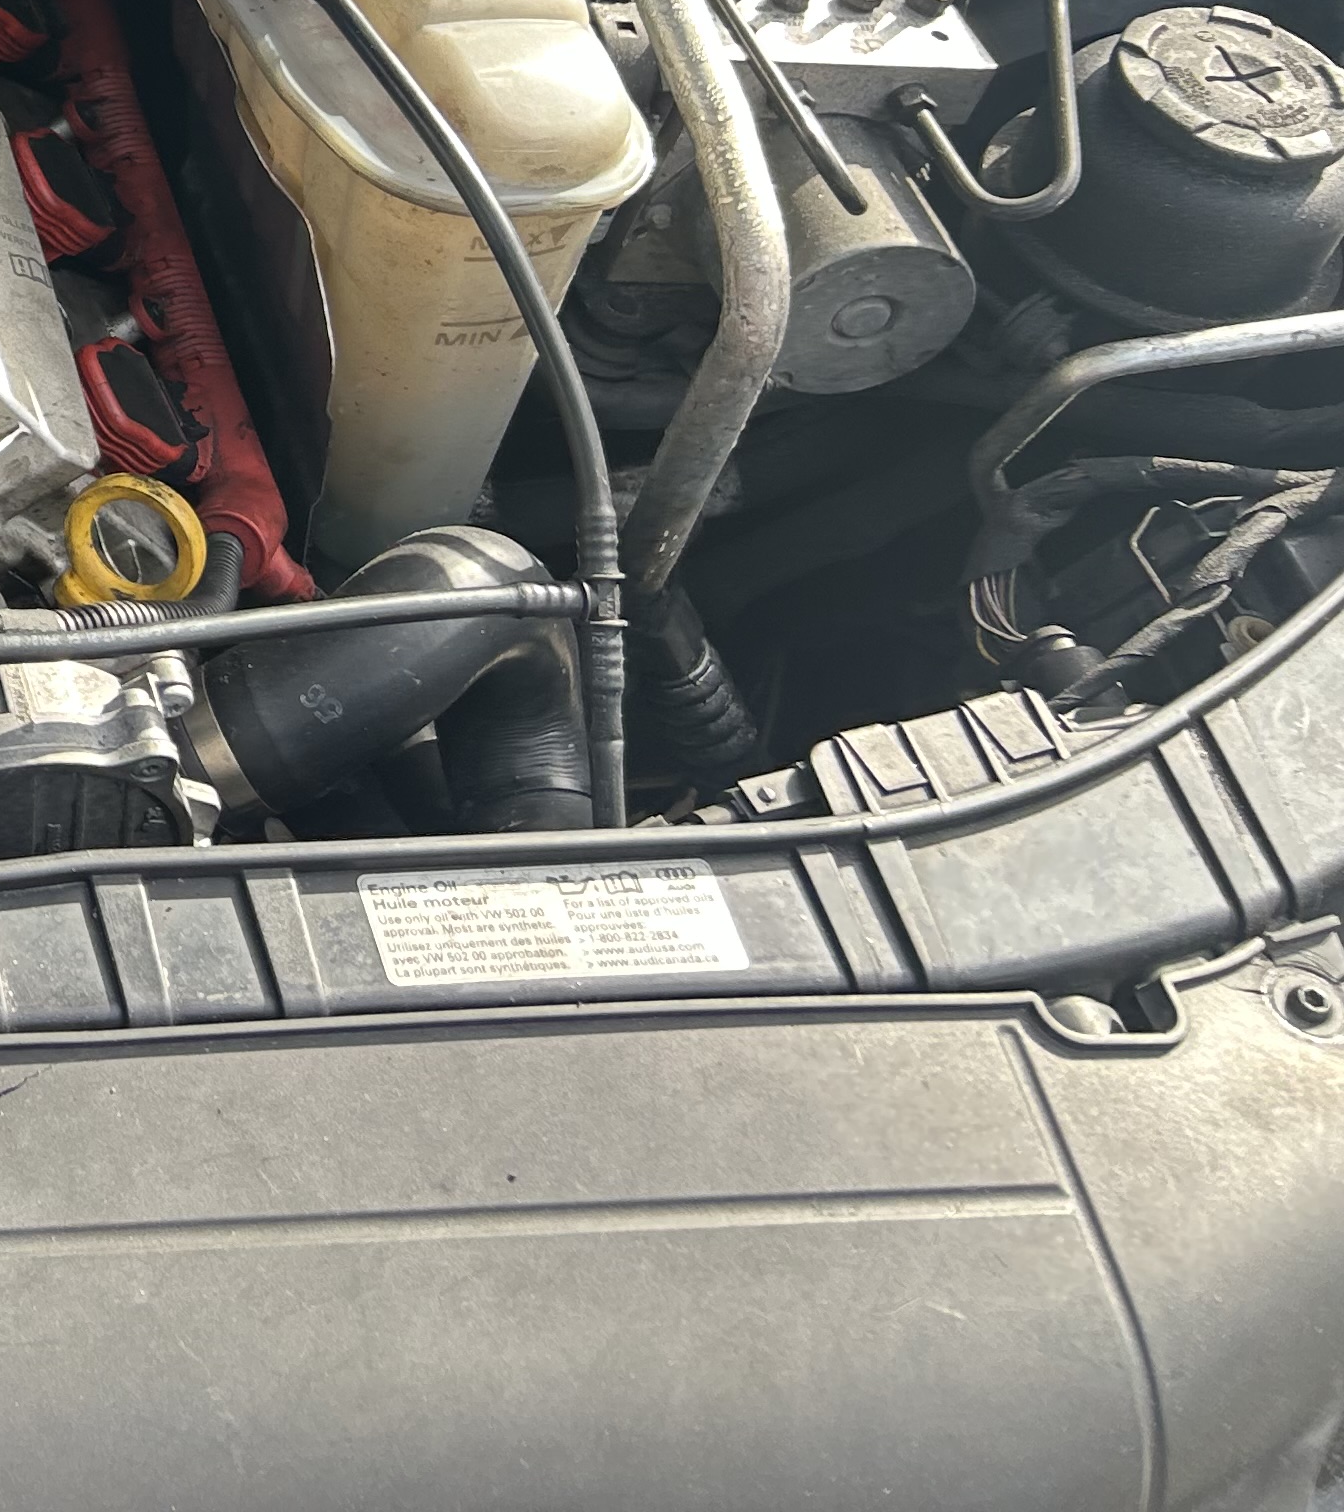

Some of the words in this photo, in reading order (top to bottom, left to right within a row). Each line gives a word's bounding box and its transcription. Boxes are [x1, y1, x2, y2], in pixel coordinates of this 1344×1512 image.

[435, 331, 502, 346] MIN
[368, 883, 428, 897] Engine
[433, 880, 457, 892] Oil
[373, 898, 418, 910] Huile
[423, 896, 489, 908] moteur
[563, 899, 583, 909] For
[587, 900, 595, 908] a
[596, 898, 616, 907] list
[619, 896, 630, 906] of
[634, 895, 690, 906] approved
[693, 893, 714, 902] oils
[378, 915, 402, 925] Use
[405, 913, 430, 925] only
[434, 912, 449, 923] oil
[480, 909, 502, 919] VW
[503, 908, 528, 919] 502
[530, 907, 545, 918] 00
[567, 910, 595, 920] Pour
[600, 911, 622, 919] une
[625, 908, 650, 918] liste
[442, 923, 473, 936] Most
[476, 924, 496, 932] are
[387, 942, 432, 953] Utilisez
[434, 939, 508, 951] uniquement
[511, 937, 533, 946] des
[534, 934, 571, 945] huiles
[593, 943, 705, 955] www.audiusa.com
[393, 956, 420, 965] avec
[422, 953, 443, 963] VW
[446, 951, 470, 962] 502
[472, 951, 487, 960] 00
[596, 953, 719, 968] www.audicanada.ca
[395, 968, 411, 978] La
[414, 966, 458, 978] plupart
[460, 965, 487, 975] sont
